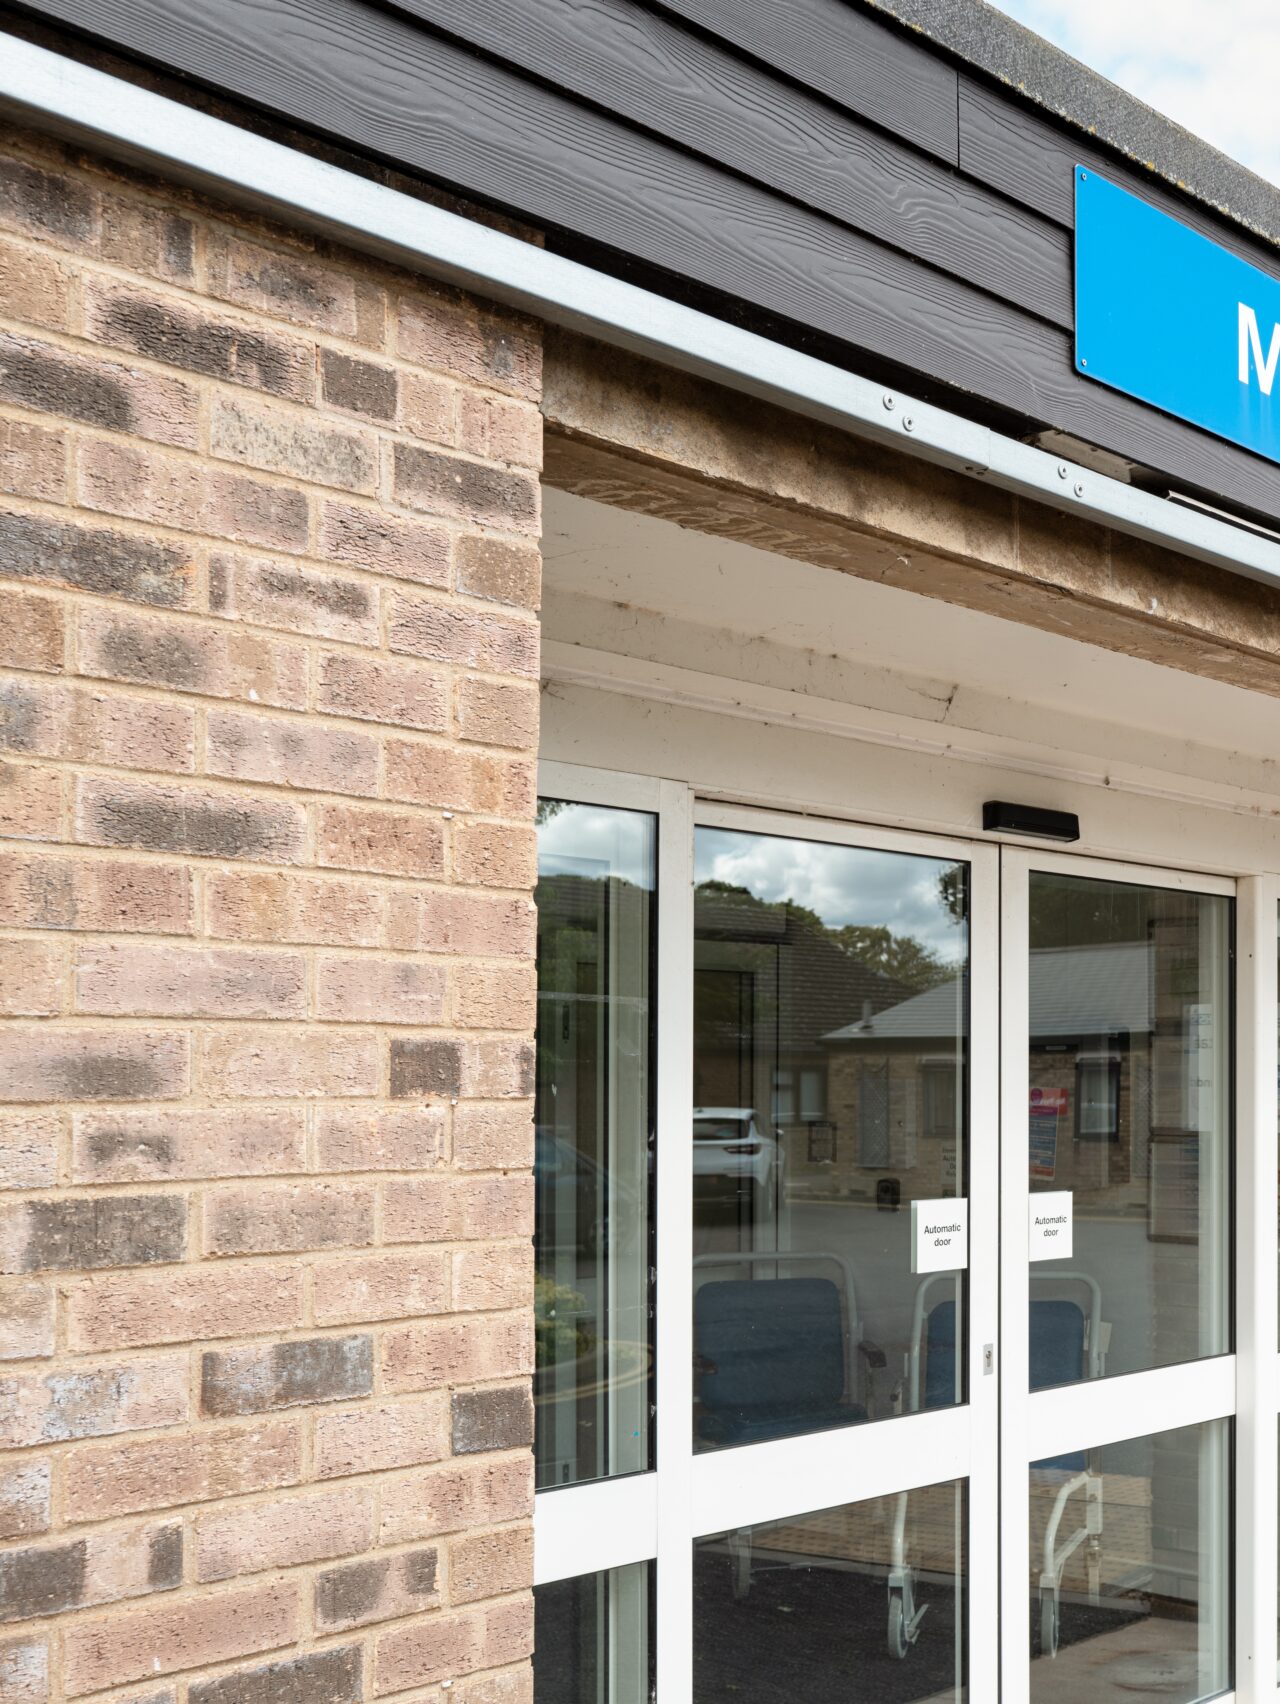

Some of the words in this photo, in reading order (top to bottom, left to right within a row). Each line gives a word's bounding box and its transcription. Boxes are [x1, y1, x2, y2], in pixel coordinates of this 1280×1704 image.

[1035, 1215, 1067, 1225] Automatic
[924, 1224, 961, 1235] Automatic
[1043, 1229, 1059, 1237] door
[934, 1238, 951, 1247] door
